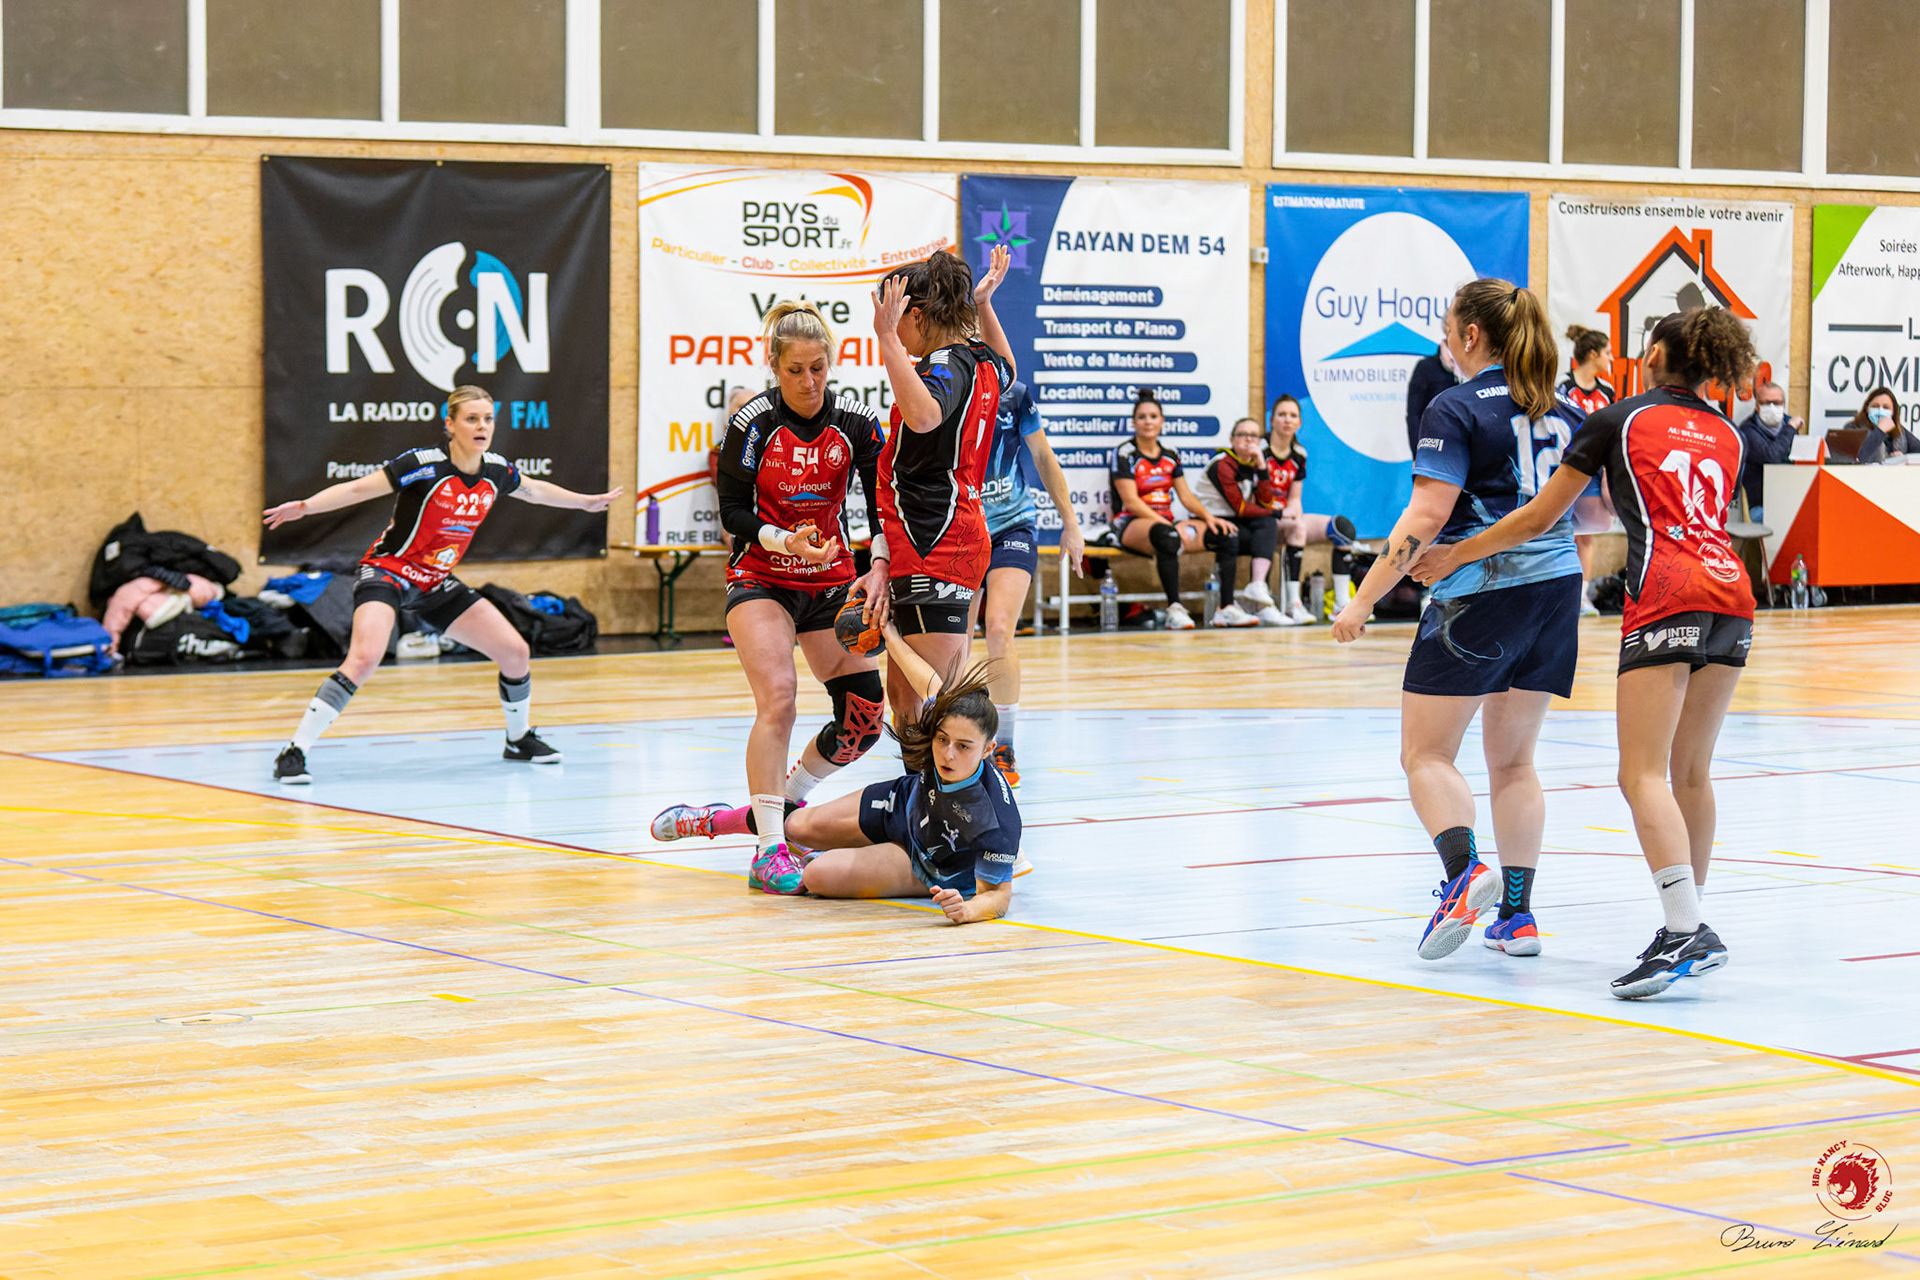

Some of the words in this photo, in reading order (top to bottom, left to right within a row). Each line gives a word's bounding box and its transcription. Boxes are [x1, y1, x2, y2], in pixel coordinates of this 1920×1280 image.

[1273, 195, 1324, 208] ESTIMATION
[1324, 197, 1365, 210] GRATUITE
[1558, 201, 1641, 217] Construisons
[1645, 204, 1705, 219] ensemble
[1709, 208, 1741, 221] votre
[1745, 208, 1784, 223] avenir
[742, 201, 818, 224] PAYS
[823, 214, 838, 225] du
[743, 225, 839, 248] SPORT
[1056, 231, 1135, 251] RAYAN
[1141, 233, 1189, 255] DEM
[1198, 236, 1226, 256] 54
[1879, 238, 1918, 254] Soirées
[651, 236, 726, 266] Particulier
[742, 256, 774, 271] Club
[789, 256, 867, 272] Collectivité
[881, 235, 949, 266] Entreprise
[1837, 262, 1896, 279] Afterwork,
[1897, 264, 1920, 281] Happ
[1043, 285, 1155, 307] Déménagement
[1315, 286, 1368, 325] Guy
[1378, 287, 1450, 327] Hoqu
[1043, 319, 1112, 337] Transport
[1113, 321, 1131, 335] de
[1134, 321, 1177, 336] Piano
[1043, 352, 1084, 368] Vente
[1087, 353, 1105, 367] de
[1108, 352, 1174, 368] Matériels
[1313, 368, 1408, 383] L'IMMOBILIER
[1827, 354, 1920, 394] COM
[1039, 385, 1104, 401] Location
[1106, 385, 1125, 401] de
[328, 402, 358, 422] LA
[362, 402, 436, 422] RADIO
[510, 400, 550, 429] FM
[1042, 416, 1117, 433] Particulier
[1510, 413, 1573, 496] 12
[515, 457, 553, 476] SLUC
[778, 481, 796, 493] Guy
[798, 481, 832, 493] Hoquet
[454, 493, 479, 516] 22
[666, 530, 698, 543] RUE
[1667, 626, 1701, 638] INTER
[1667, 636, 1700, 648] SPORT
